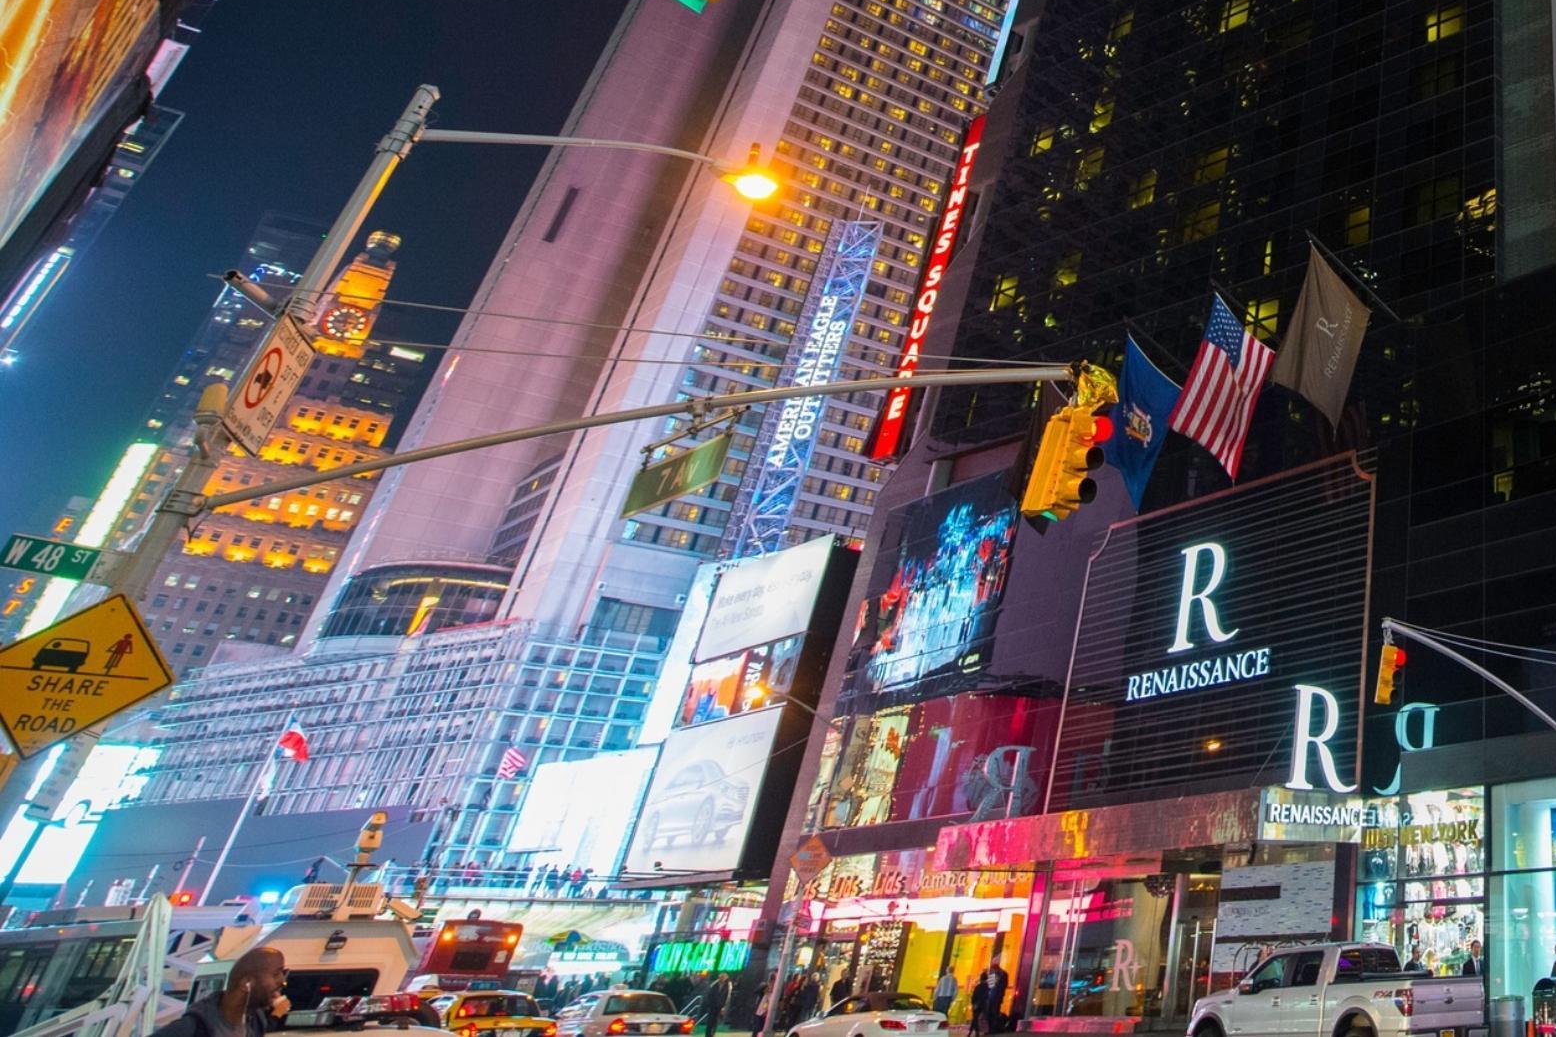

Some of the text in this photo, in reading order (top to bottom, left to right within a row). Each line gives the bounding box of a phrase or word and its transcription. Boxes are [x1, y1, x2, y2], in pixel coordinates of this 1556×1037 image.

[934, 143, 979, 254] TIMES
[767, 296, 838, 467] AMERIAN EAGLE
[794, 319, 846, 439] OUTITTERS
[4, 538, 94, 571] W 48 ST
[1167, 541, 1240, 654] R
[26, 674, 110, 697] SHARE
[1126, 648, 1271, 701] RENAISSANCE
[41, 698, 74, 712] THE
[13, 714, 77, 734] ROAD
[1284, 684, 1358, 793] R
[1270, 803, 1367, 827] RENAISSANCE
[1437, 819, 1480, 842] YORK
[832, 874, 860, 900] Lids
[873, 869, 902, 895] Lids
[914, 868, 966, 891] Jamba
